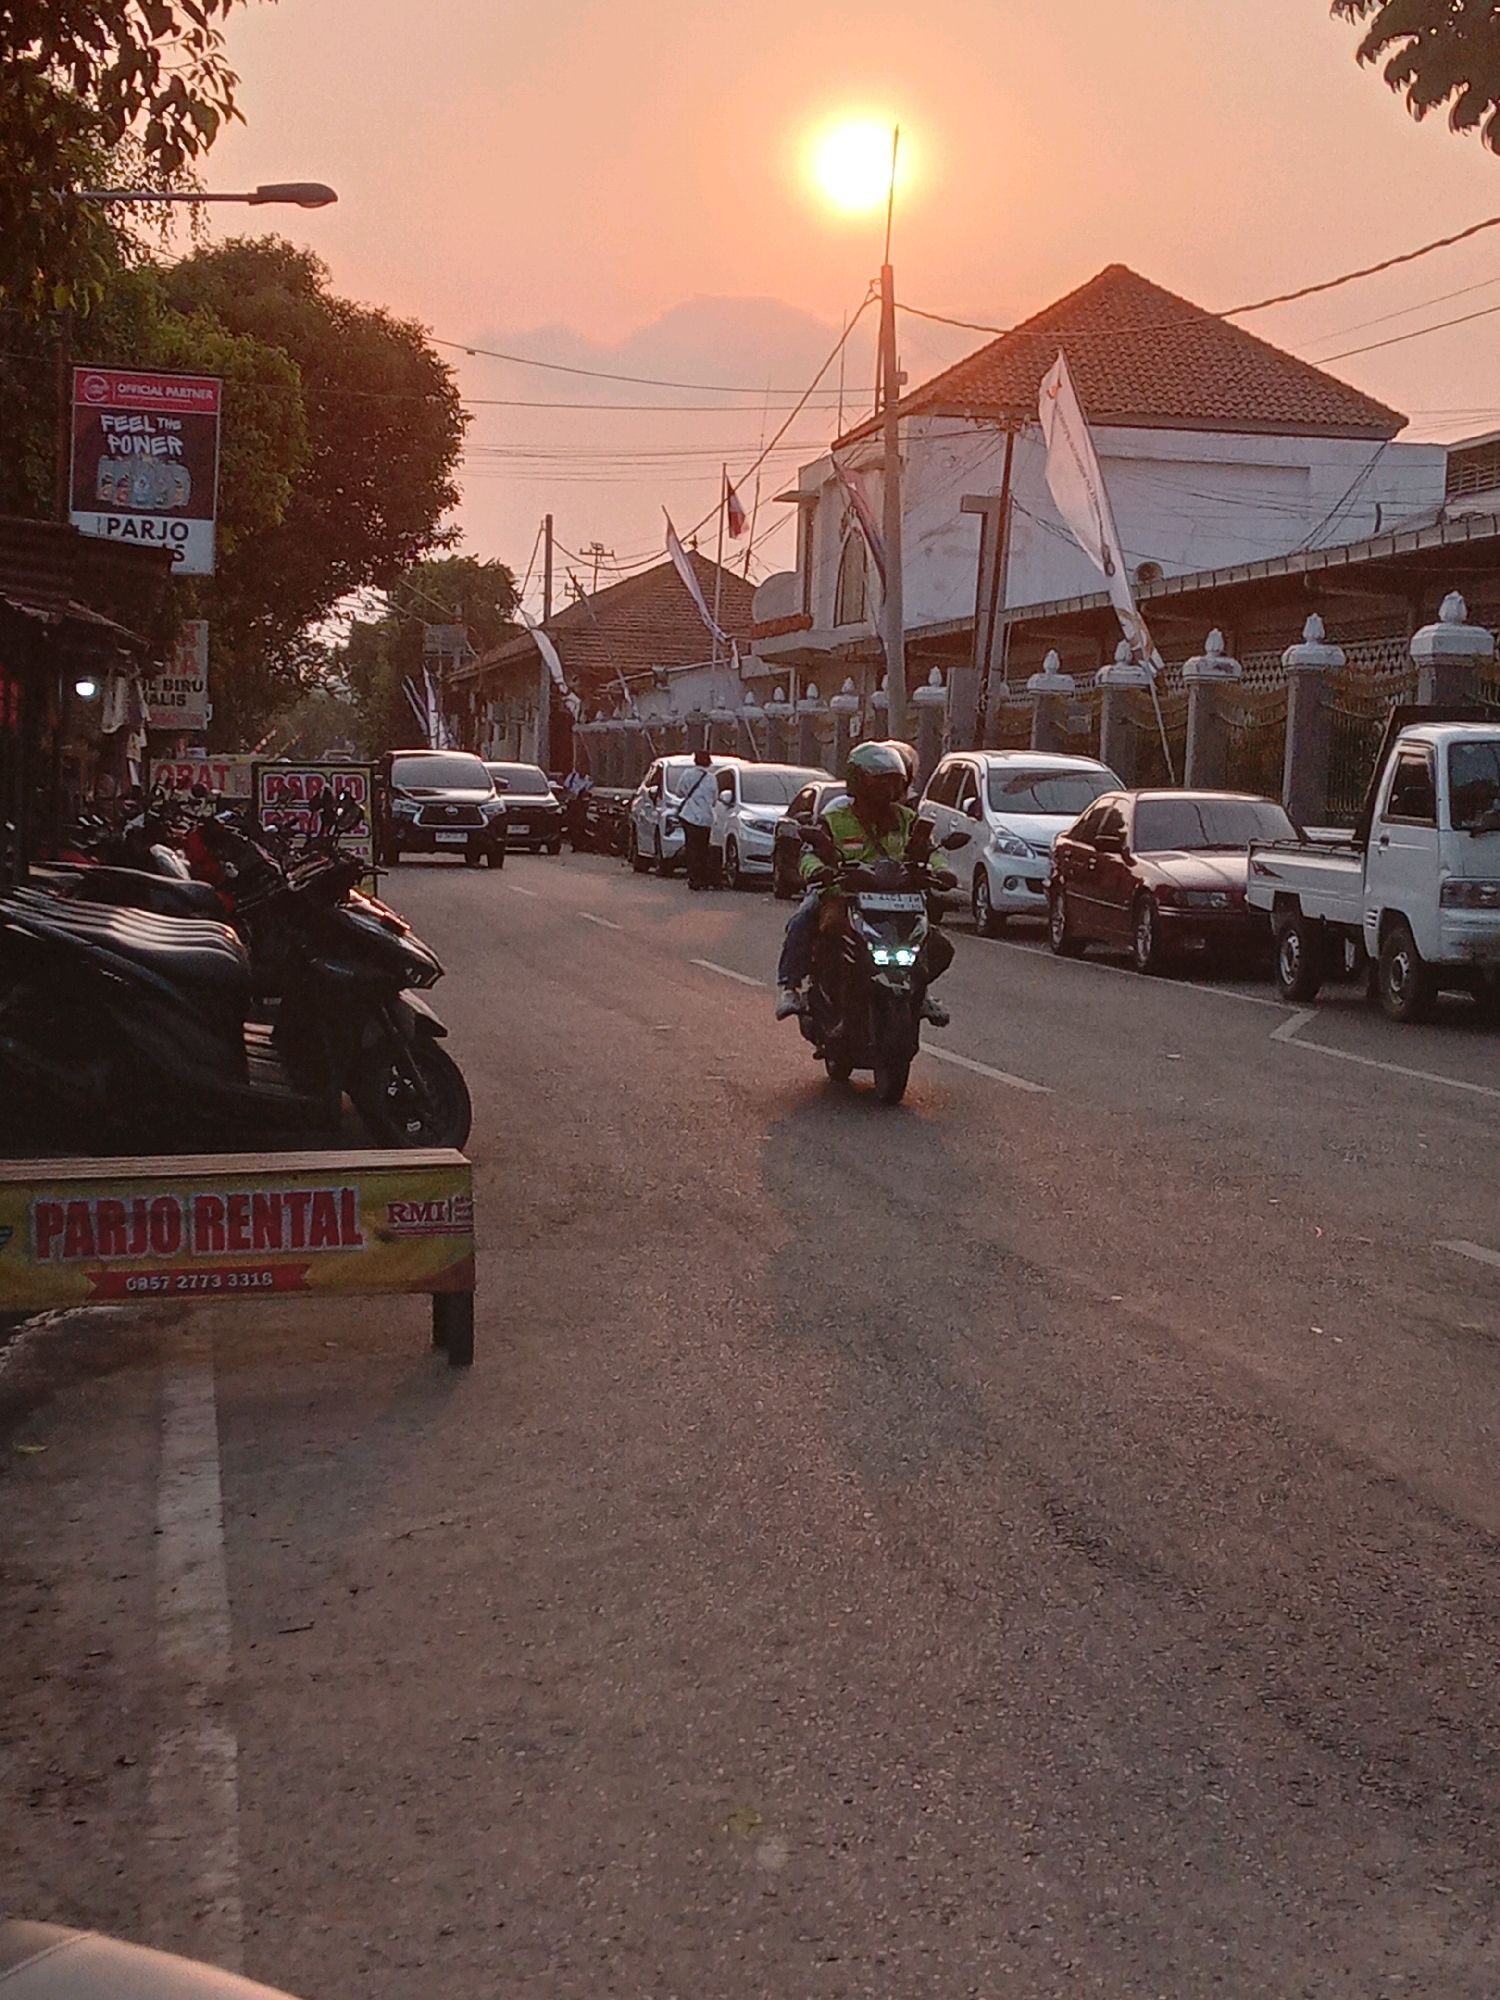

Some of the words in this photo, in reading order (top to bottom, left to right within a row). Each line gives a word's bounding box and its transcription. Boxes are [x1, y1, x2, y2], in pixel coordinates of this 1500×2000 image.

[117, 382, 164, 397] OFFICIAL
[166, 386, 214, 400] PARTNER
[100, 414, 157, 434] FEEL
[108, 434, 184, 456] POWER
[107, 517, 189, 542] PARJO
[162, 679, 204, 693] BIRU
[387, 1201, 446, 1223] RMI
[34, 1194, 182, 1260] PARJO
[193, 1189, 364, 1253] RENTAL
[126, 1275, 170, 1291] 0857
[176, 1273, 222, 1290] 2773
